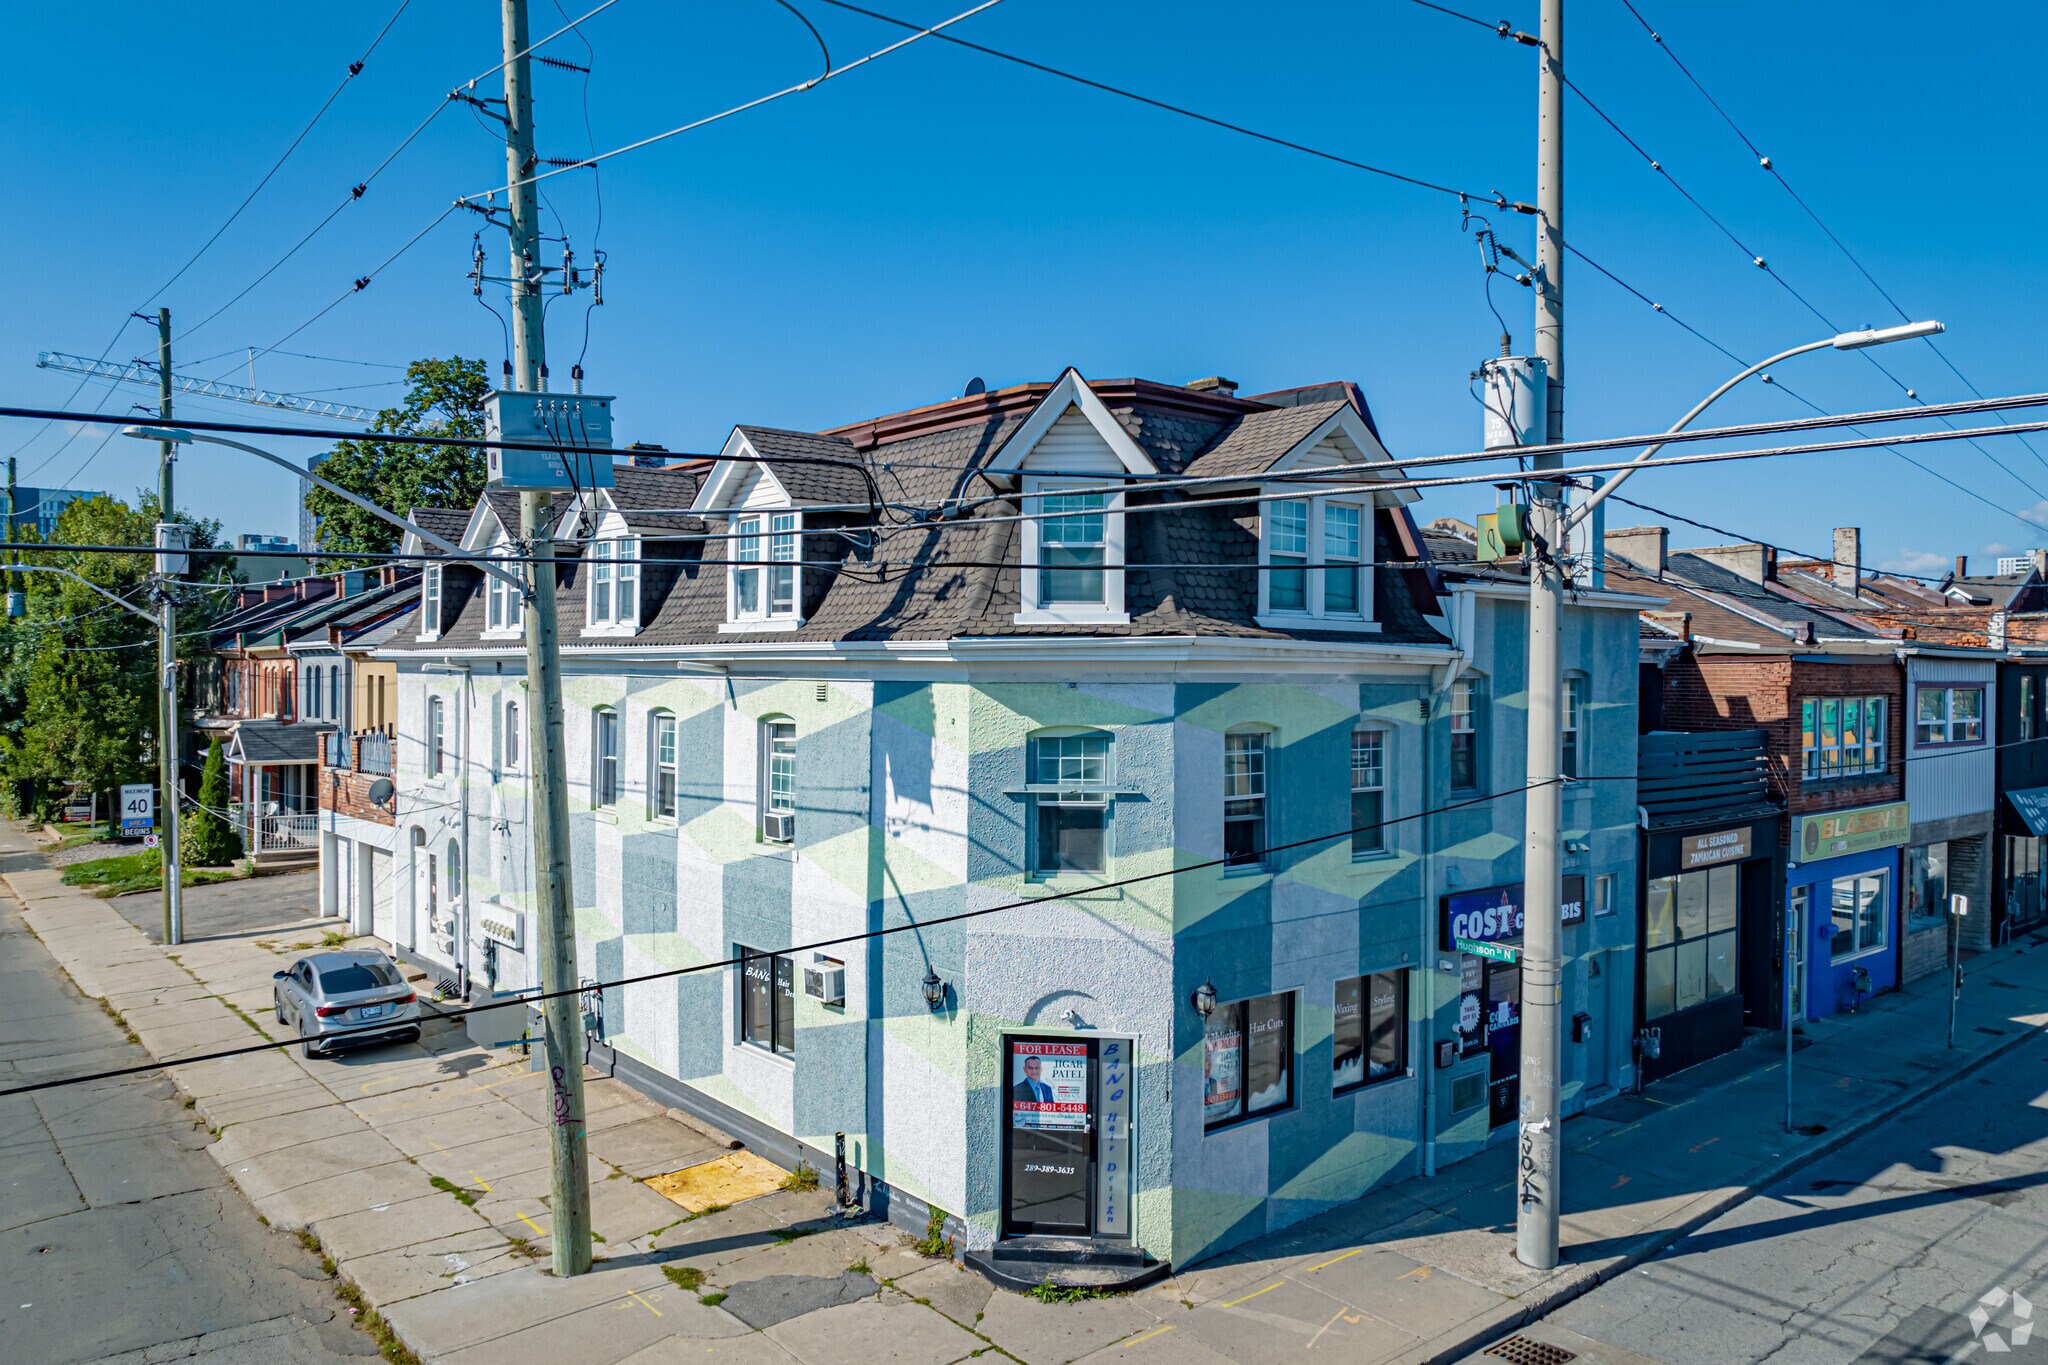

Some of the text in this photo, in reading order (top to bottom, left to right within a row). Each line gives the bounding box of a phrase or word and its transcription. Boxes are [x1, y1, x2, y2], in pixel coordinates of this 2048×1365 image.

[1491, 419, 1502, 430] 75
[128, 799, 148, 813] 40
[1821, 810, 1890, 840] BLAZEN
[124, 827, 151, 836] BEGINS
[1697, 832, 1738, 850] ALL SEASONED
[1691, 844, 1745, 864] JAMAICAN CUISINE
[1453, 905, 1513, 940] COST
[1456, 939, 1496, 957] Hughson
[1503, 949, 1512, 960] N
[1461, 960, 1476, 969] RDER
[745, 966, 770, 981] BANG
[778, 978, 790, 988] Hair
[1460, 980, 1478, 989] NLINE
[1249, 1018, 1284, 1034] Hair Cuts
[1019, 1044, 1080, 1055] FOR LEASE
[1053, 1059, 1083, 1069] JIGAR
[1052, 1069, 1085, 1079] PATEL
[1020, 1102, 1084, 1113] 647-801-5448
[1025, 1164, 1075, 1175] 289-389-3635
[1106, 1162, 1117, 1223] Design
